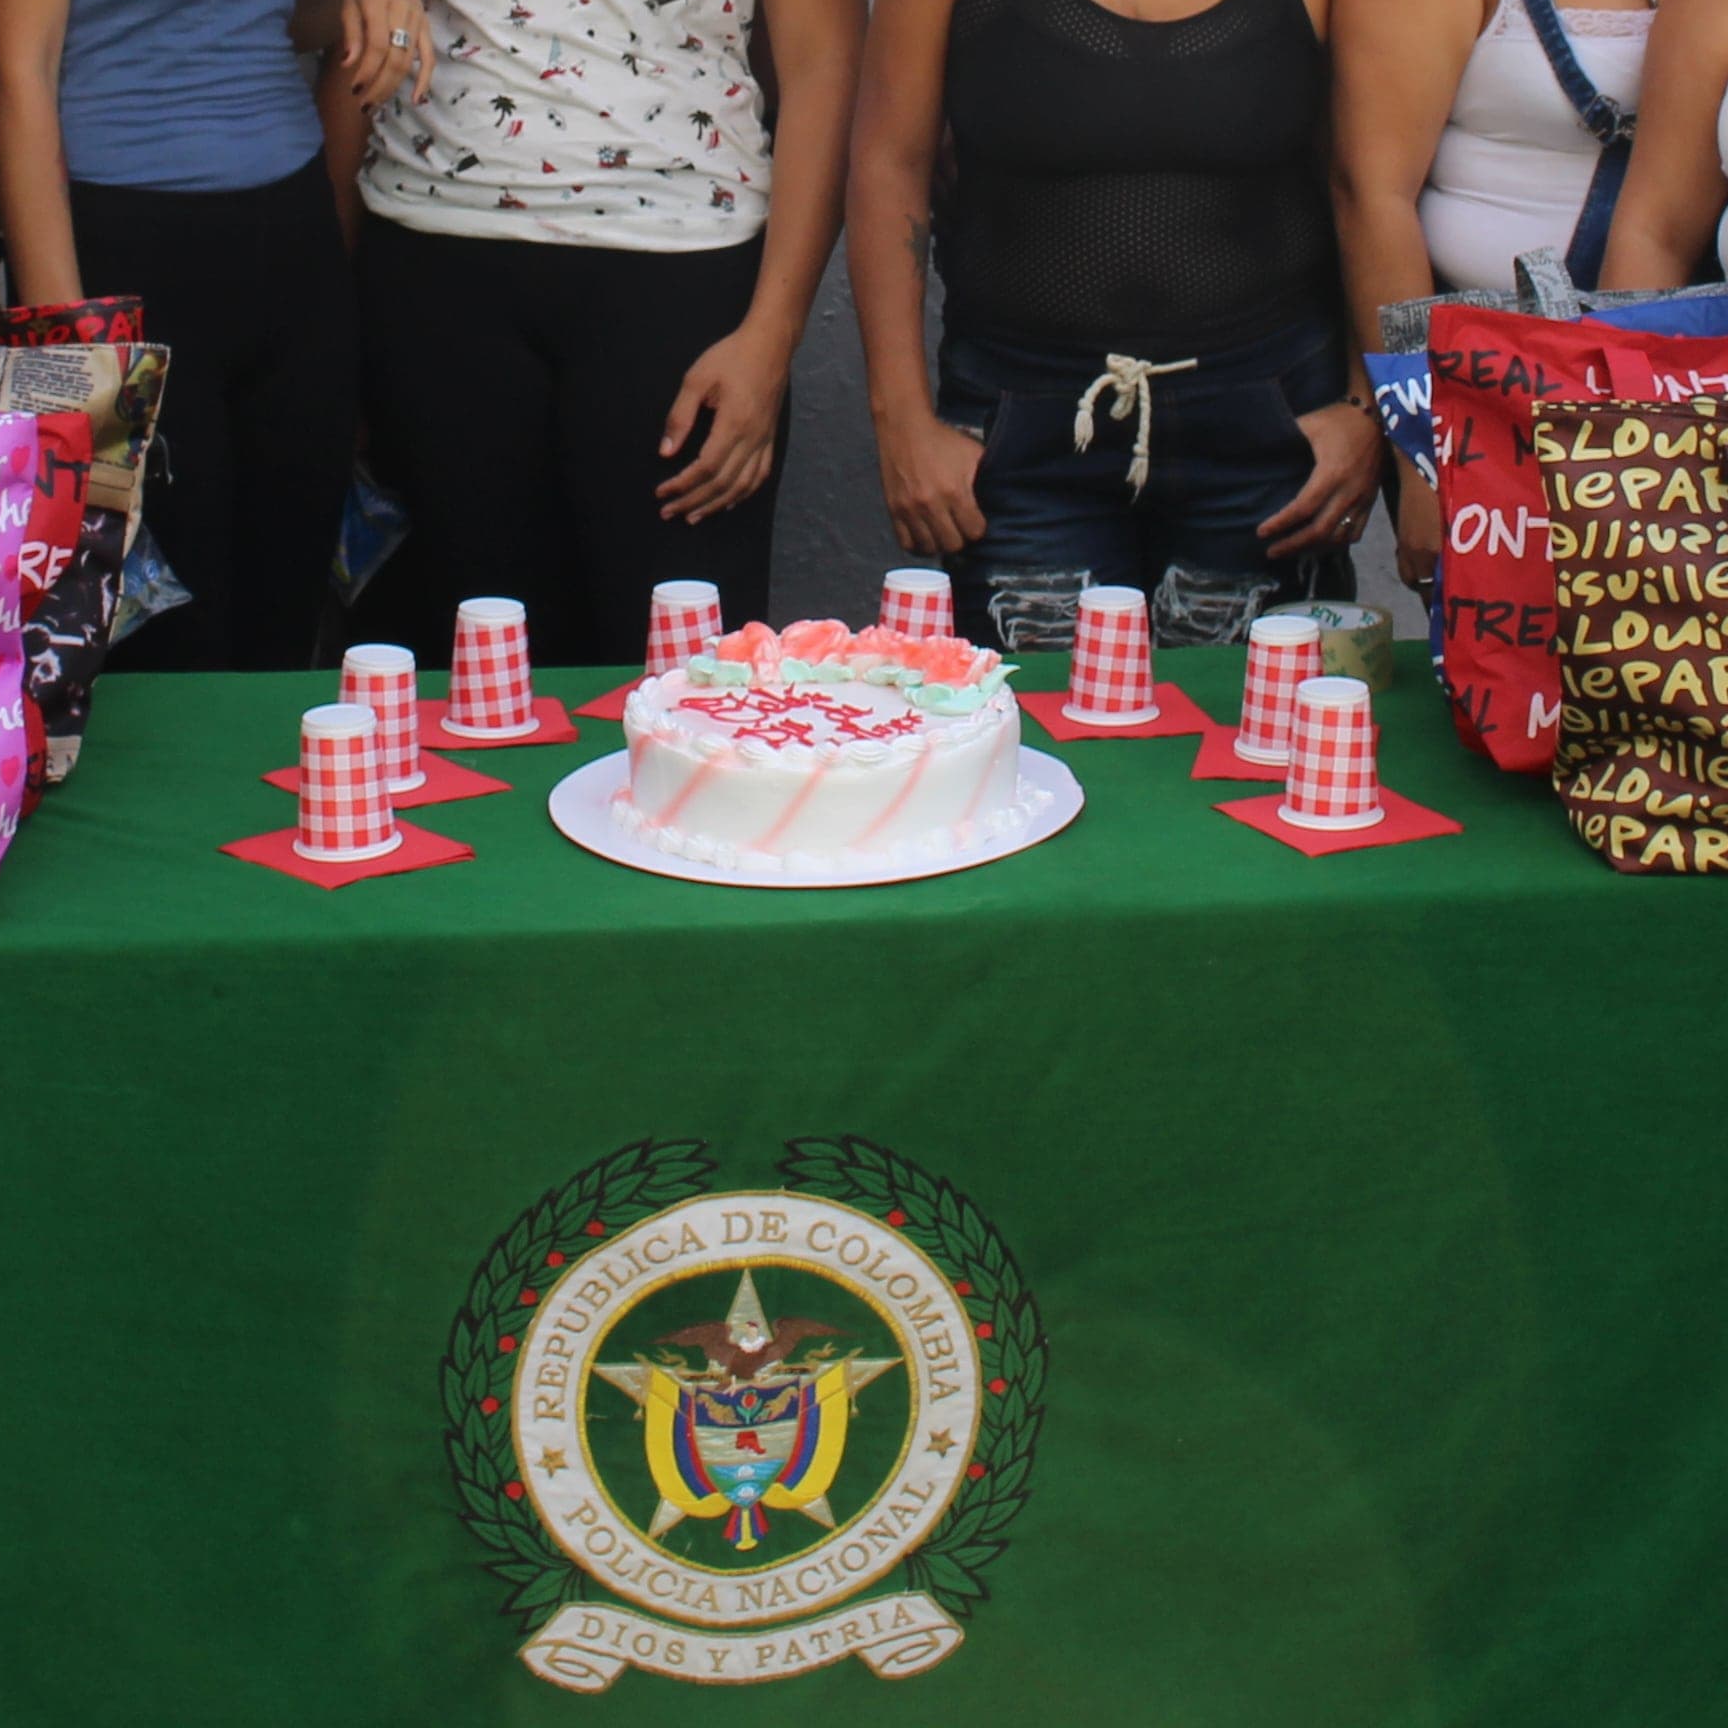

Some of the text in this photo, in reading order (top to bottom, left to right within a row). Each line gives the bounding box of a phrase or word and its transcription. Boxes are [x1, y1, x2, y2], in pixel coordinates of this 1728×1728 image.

[533, 1211, 961, 1424] REPUBLICA DE COLOMBIA
[562, 1476, 937, 1614] POLICIA NACIONAL
[580, 1602, 918, 1673] DIOS Y PATRIA
